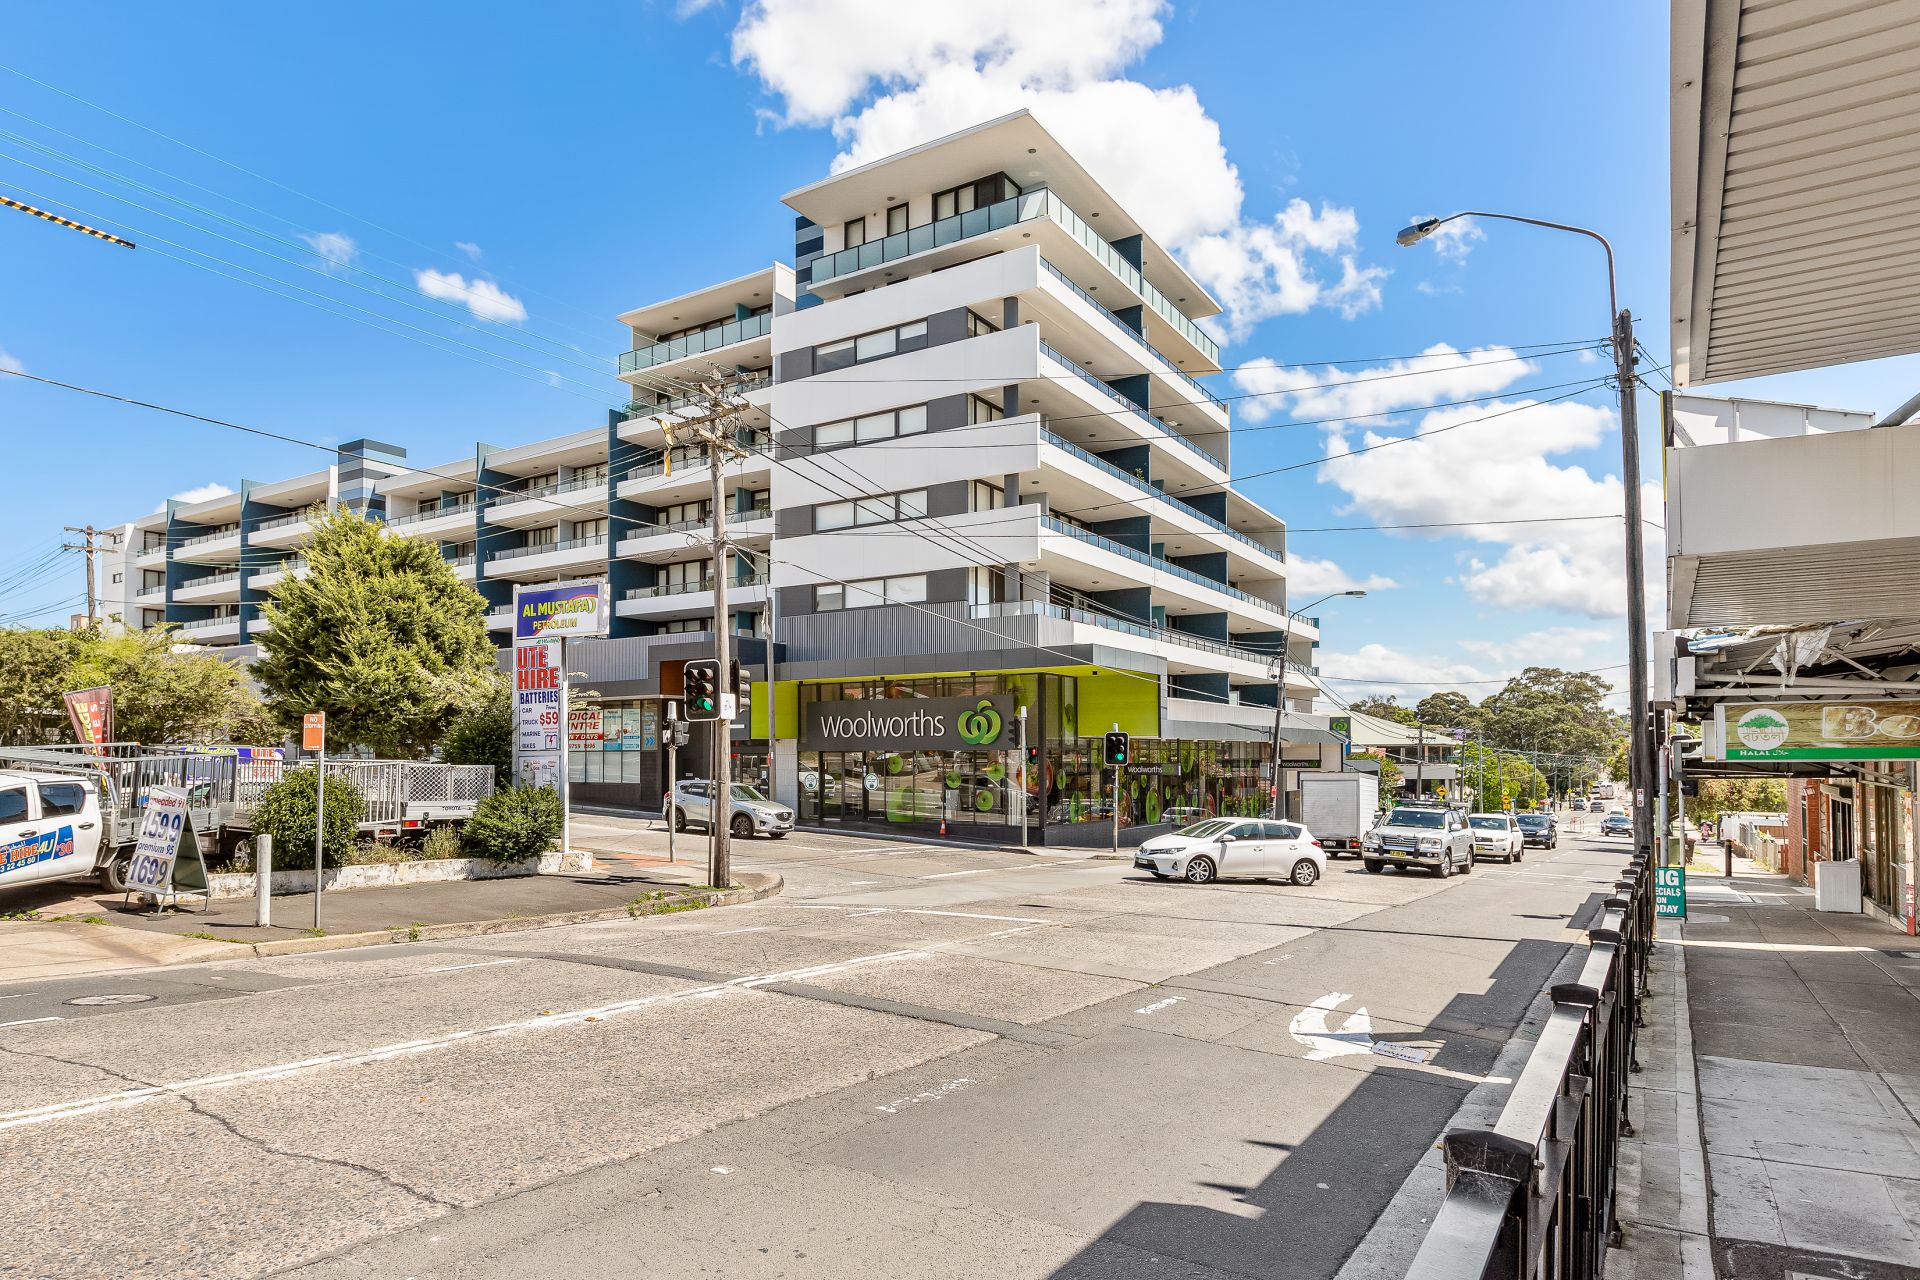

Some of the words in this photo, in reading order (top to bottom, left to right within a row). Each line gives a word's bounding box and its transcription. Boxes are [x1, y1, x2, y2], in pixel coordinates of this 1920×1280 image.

[522, 603, 537, 618] AL
[537, 599, 590, 615] MUSTAFA
[532, 617, 578, 631] PETROLEUM
[517, 645, 549, 669] UTE
[517, 667, 561, 690] HIRE
[520, 690, 559, 705] BATTERIES
[539, 711, 559, 726] $59
[570, 712, 603, 720] DICAL
[570, 722, 600, 730] NTRE
[821, 709, 945, 738] Woolworths
[252, 748, 275, 758] UTE
[10, 843, 38, 861] HIRE
[137, 842, 165, 854] premium
[165, 844, 175, 855] 95
[1655, 869, 1680, 886] IG
[1655, 887, 1681, 896] ECIALS
[1656, 896, 1667, 904] ON
[1655, 904, 1679, 914] ODAY
